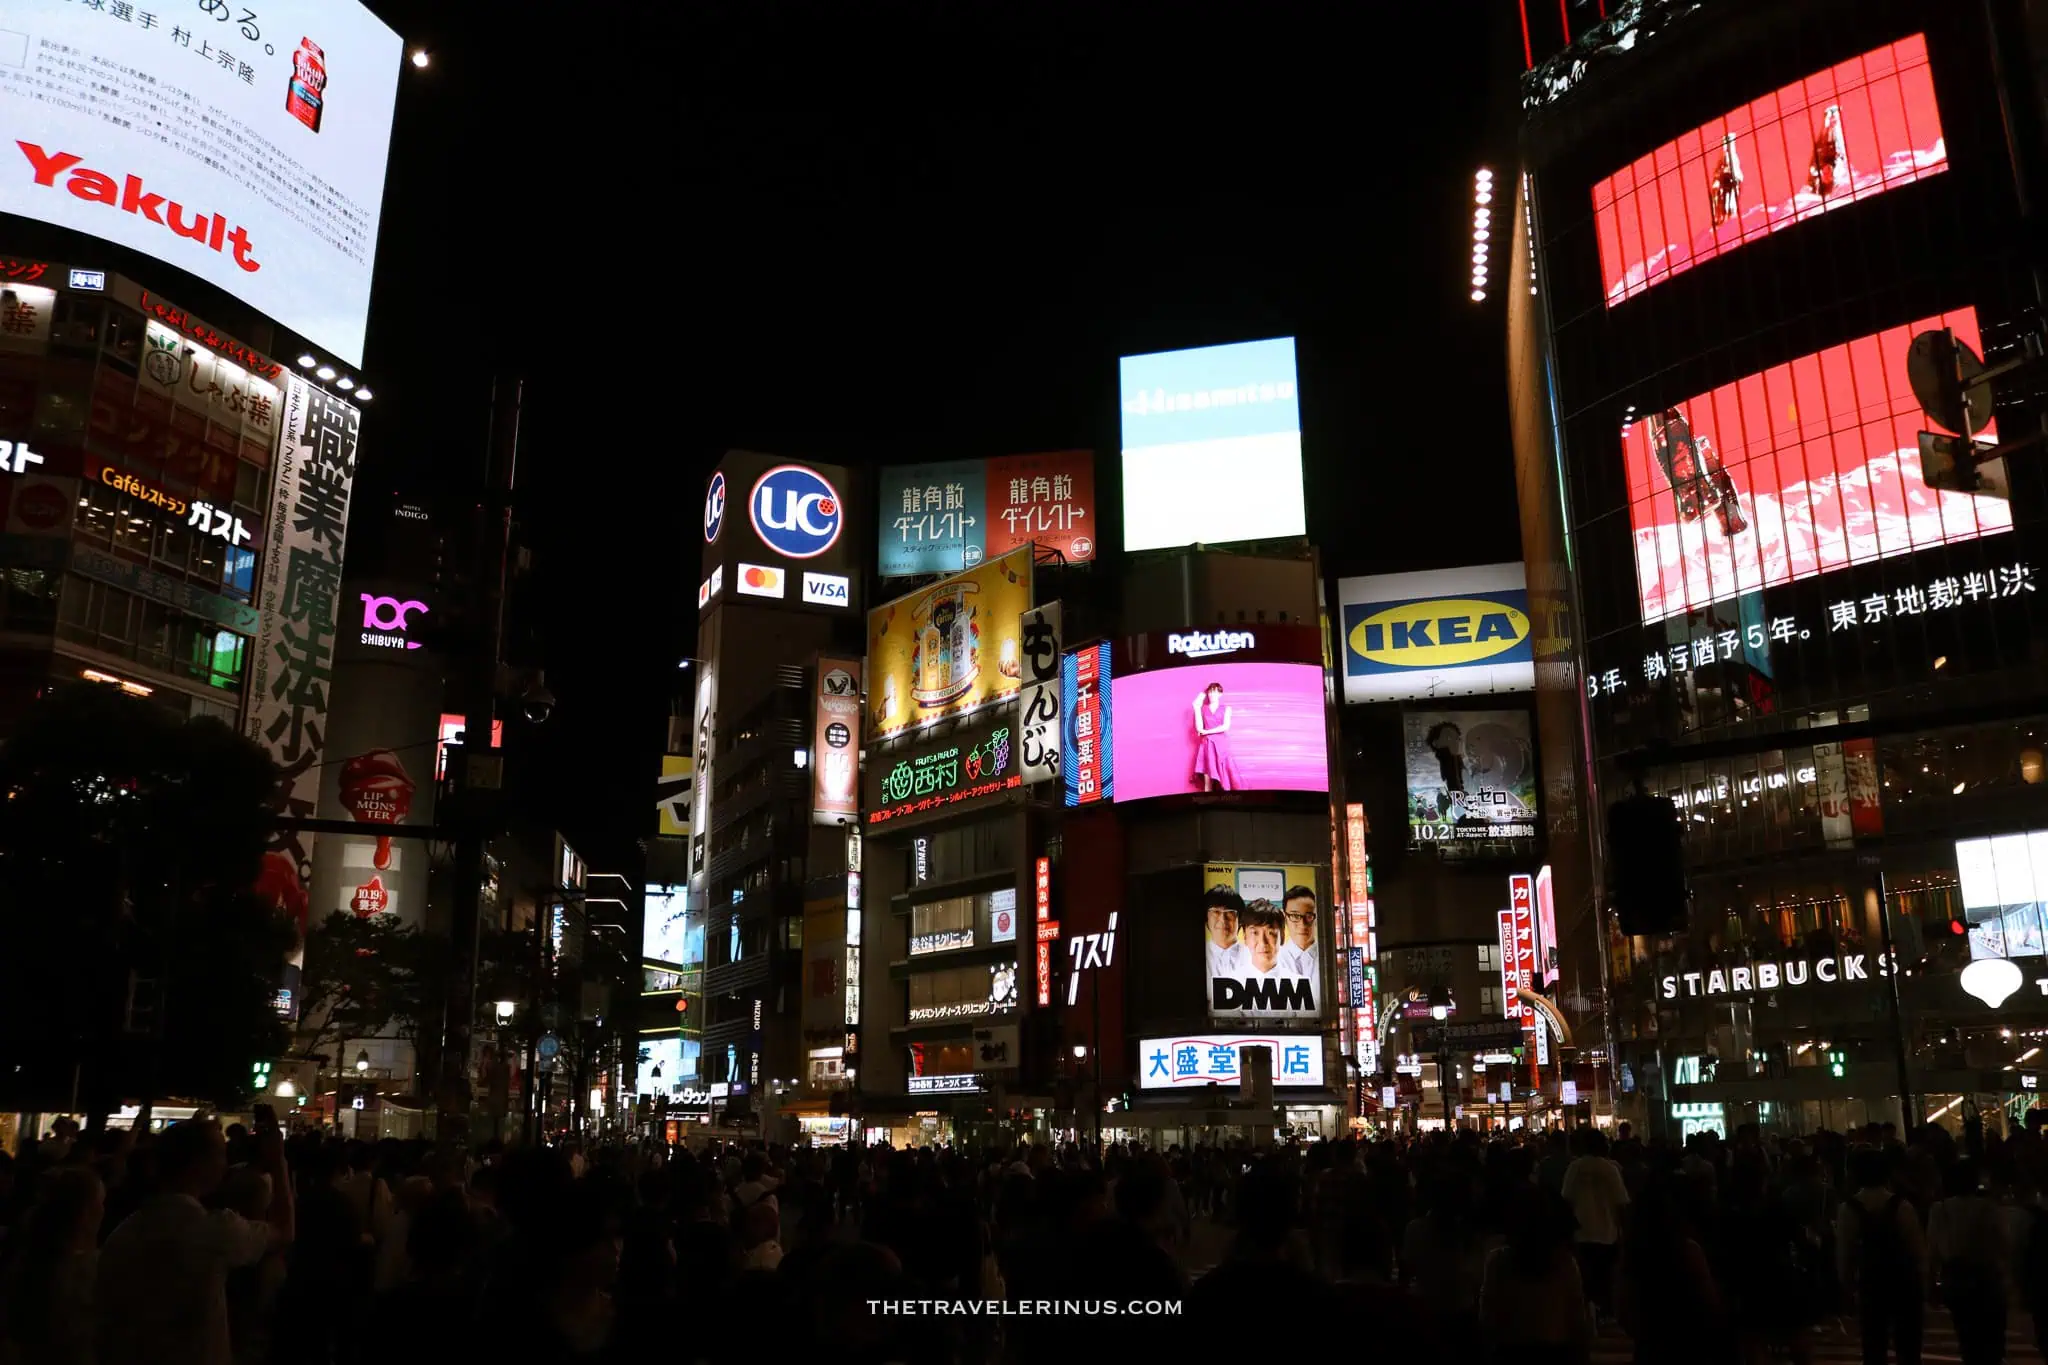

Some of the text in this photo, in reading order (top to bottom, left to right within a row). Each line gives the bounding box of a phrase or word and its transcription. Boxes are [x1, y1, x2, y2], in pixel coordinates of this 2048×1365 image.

[16, 140, 261, 273] Yakult
[0, 258, 48, 282] ング
[903, 482, 965, 514] 龍角散
[1010, 474, 1073, 505] 龍角散
[188, 499, 252, 546] ガスト
[395, 508, 429, 521] INDIGO
[760, 485, 834, 537] UC
[807, 580, 847, 599] VISA
[1829, 563, 2037, 633] 東京地裁判決
[361, 633, 405, 649] SHIBUYA
[1168, 630, 1255, 654] Rakuten
[1023, 611, 1060, 775] もんじゃ
[1077, 653, 1095, 795] 三千里薬品
[914, 760, 959, 795] 西村
[357, 800, 397, 812] MONS
[363, 792, 384, 801] LIP
[366, 810, 391, 820] TER
[1413, 824, 1450, 840] 10.2
[917, 838, 927, 881] CAMERA
[1514, 886, 1533, 961] カラオケ
[1662, 952, 1899, 999] STARBUCKS
[1212, 977, 1316, 1011] DMM
[1149, 1044, 1310, 1078] 大盛堂店
